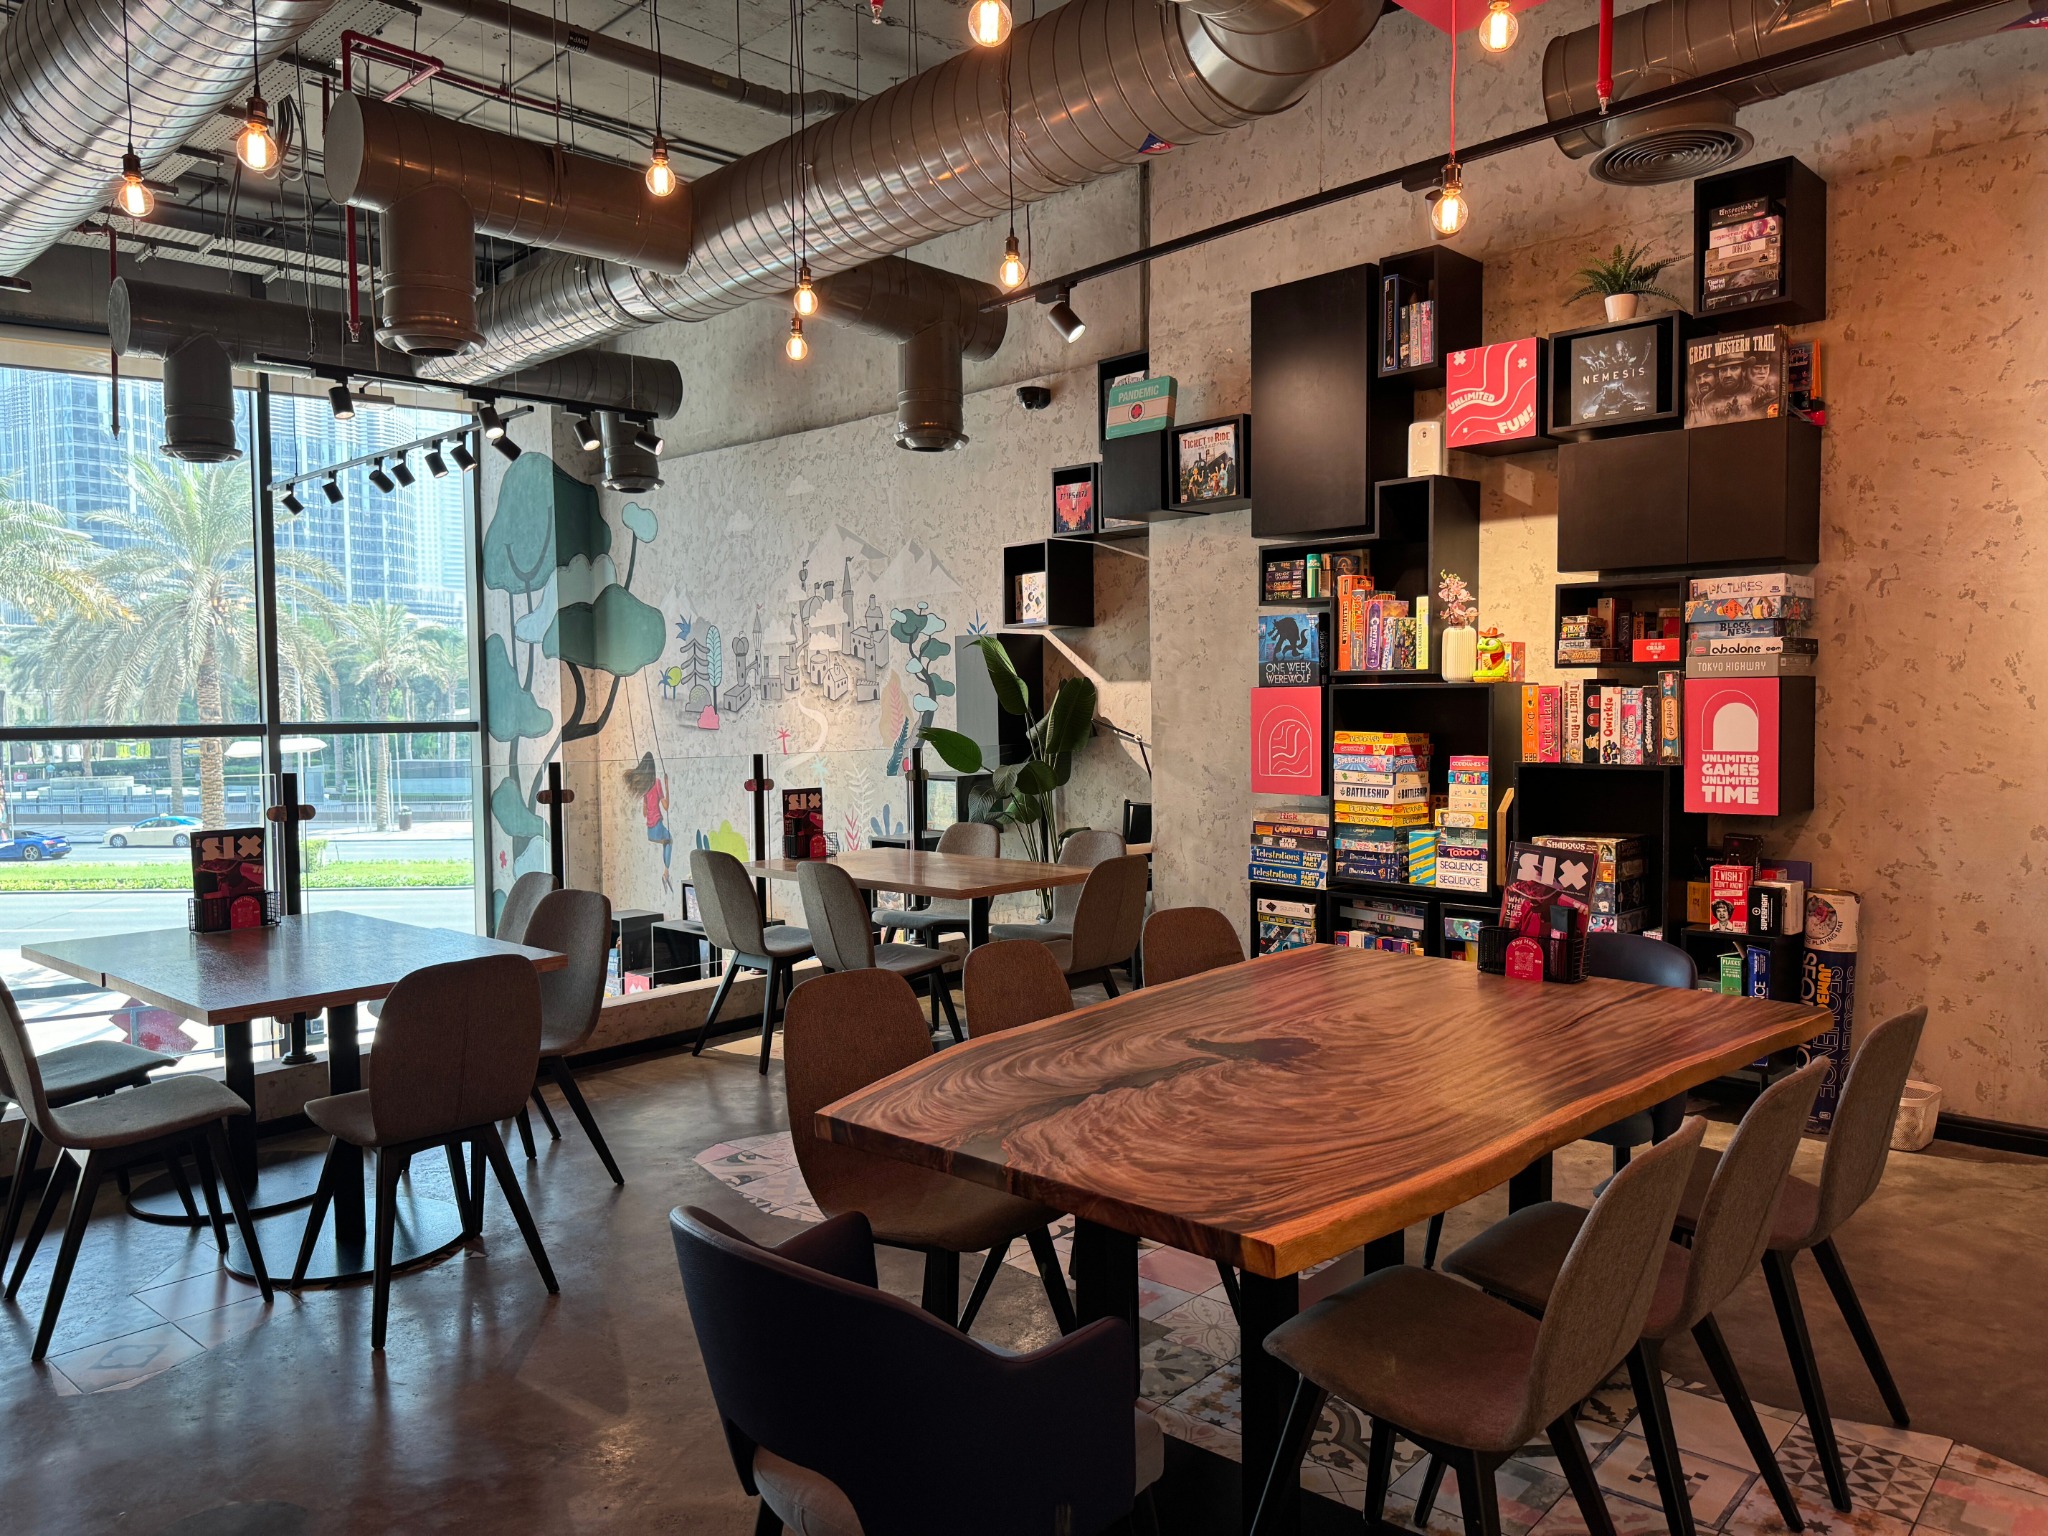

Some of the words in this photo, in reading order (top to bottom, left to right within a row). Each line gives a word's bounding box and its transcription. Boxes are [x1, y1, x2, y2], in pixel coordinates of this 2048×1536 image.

[1689, 343, 1712, 365] GREAT
[1714, 337, 1750, 357] WESTERN
[1752, 333, 1776, 351] TRAIL
[1582, 366, 1645, 385] NEMESIS
[1118, 385, 1159, 403] PANDEMIC
[1447, 390, 1495, 412] UNLIMITED
[1496, 403, 1535, 434] FUN!
[1183, 438, 1206, 450] TICKET
[1214, 431, 1231, 443] RIDE
[1708, 580, 1763, 595] PICTURES
[1354, 615, 1364, 640] ALLEY
[1720, 621, 1750, 632] BLOCK
[1727, 628, 1752, 637] NESS
[1371, 617, 1380, 653] CENTURY
[1711, 643, 1761, 654] abalone
[1266, 662, 1284, 673] ONE
[1286, 662, 1311, 672] WEEK
[1697, 662, 1723, 671] TOKYO
[1725, 661, 1766, 671] HIGHWAY
[1266, 673, 1312, 684] WEREWOLF
[1569, 684, 1580, 714] TICKET
[1603, 696, 1613, 737] Qwirkle
[1644, 697, 1655, 743] Scattergories
[1539, 693, 1555, 757] Articulate!
[1570, 724, 1581, 744] RIDE
[1701, 754, 1759, 763] UNLIMITED
[1701, 763, 1759, 776] GAMES
[1455, 772, 1481, 785] CAHOOTS
[1701, 776, 1759, 785] UNLIMITED
[1346, 787, 1390, 798] BATTLESHIP
[1401, 787, 1427, 799] BATTLESHIP
[1701, 785, 1759, 804] TIME
[788, 793, 821, 811] SIX
[1348, 804, 1380, 812] PICTIONARY
[1348, 815, 1380, 824] PICTIONARY
[202, 835, 262, 861] SIX
[1279, 841, 1297, 849] WARS
[1255, 848, 1300, 862] Telestrations
[1446, 848, 1480, 857] Taboo
[1440, 860, 1483, 872] SEQUENCE
[1517, 852, 1589, 891] SIX
[1252, 867, 1297, 881] Telestrations
[1439, 874, 1480, 887] SEQUENCE
[1714, 870, 1719, 881] I
[1720, 871, 1737, 882] WISH
[1738, 872, 1743, 882] I
[1508, 895, 1525, 904] WHY
[1507, 903, 1522, 911] THE
[1760, 893, 1768, 931] SUPERFIGHT
[1505, 909, 1522, 919] SIX?
[1811, 932, 1838, 946] PLAYING
[1836, 920, 1844, 934] MAT
[1511, 939, 1523, 947] Pay
[1523, 938, 1538, 950] Here
